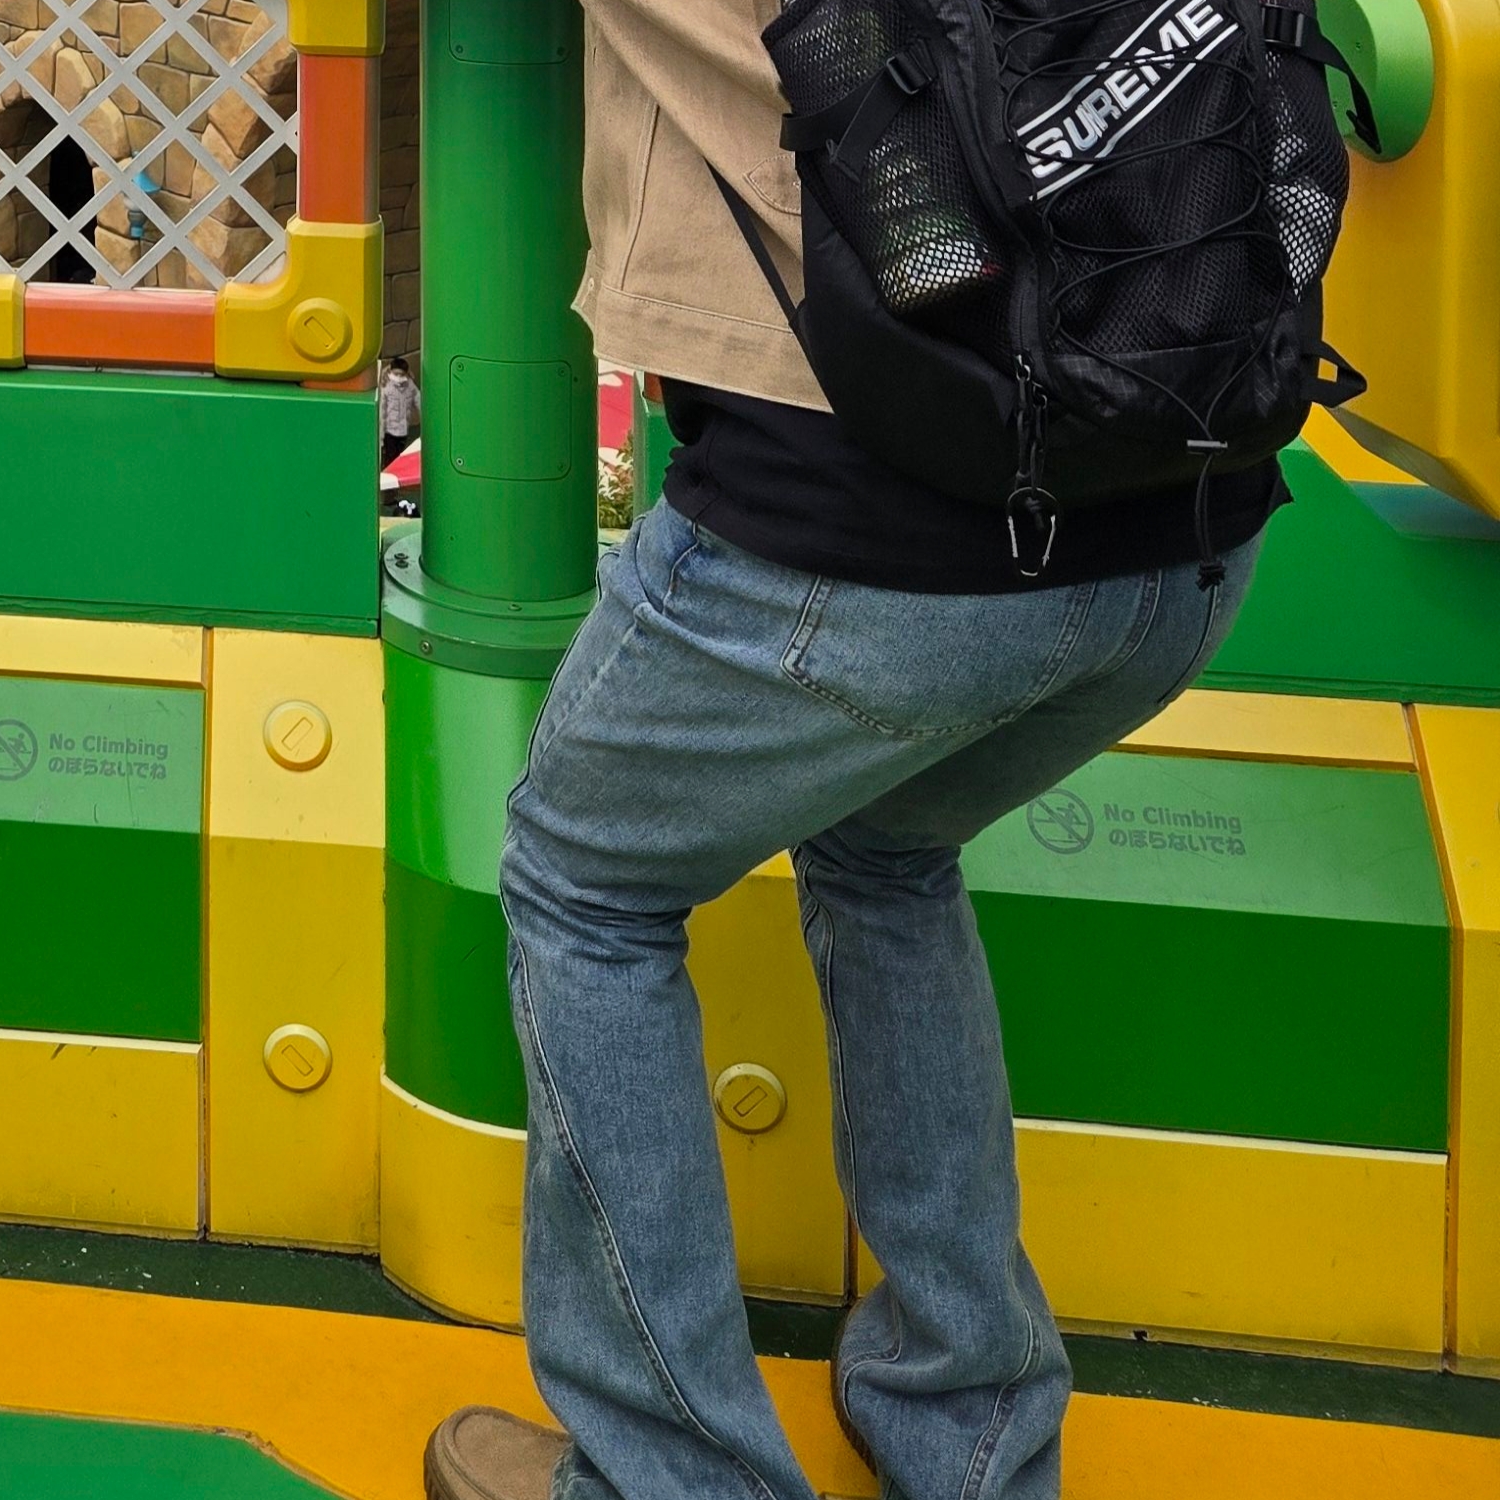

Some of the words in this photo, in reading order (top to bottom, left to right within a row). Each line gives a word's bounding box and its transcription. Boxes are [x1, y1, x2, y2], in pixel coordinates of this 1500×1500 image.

[49, 733, 75, 751] No
[82, 735, 169, 761] Climbing
[48, 756, 167, 780] のぼらないでね
[1103, 803, 1135, 822] No
[1142, 806, 1242, 834] Climbing
[1108, 828, 1246, 856] のぼらないでね
